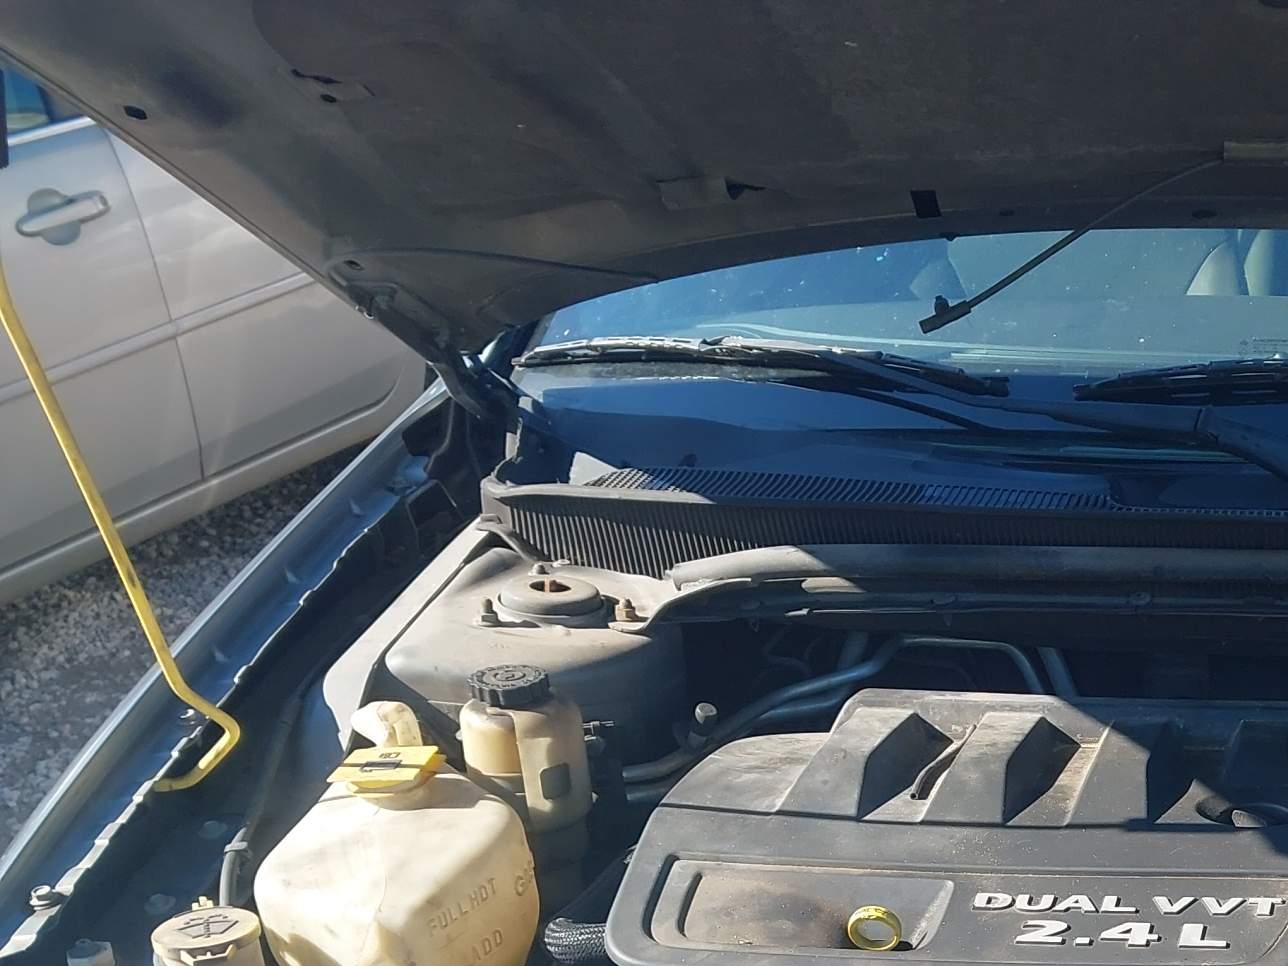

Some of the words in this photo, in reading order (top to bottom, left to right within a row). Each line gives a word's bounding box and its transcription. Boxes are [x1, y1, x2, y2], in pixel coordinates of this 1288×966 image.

[427, 901, 470, 938] FULL
[972, 892, 1140, 914] DUAL
[1152, 896, 1287, 917] VVT
[1014, 919, 1162, 948] 2.4
[1178, 923, 1231, 949] L
